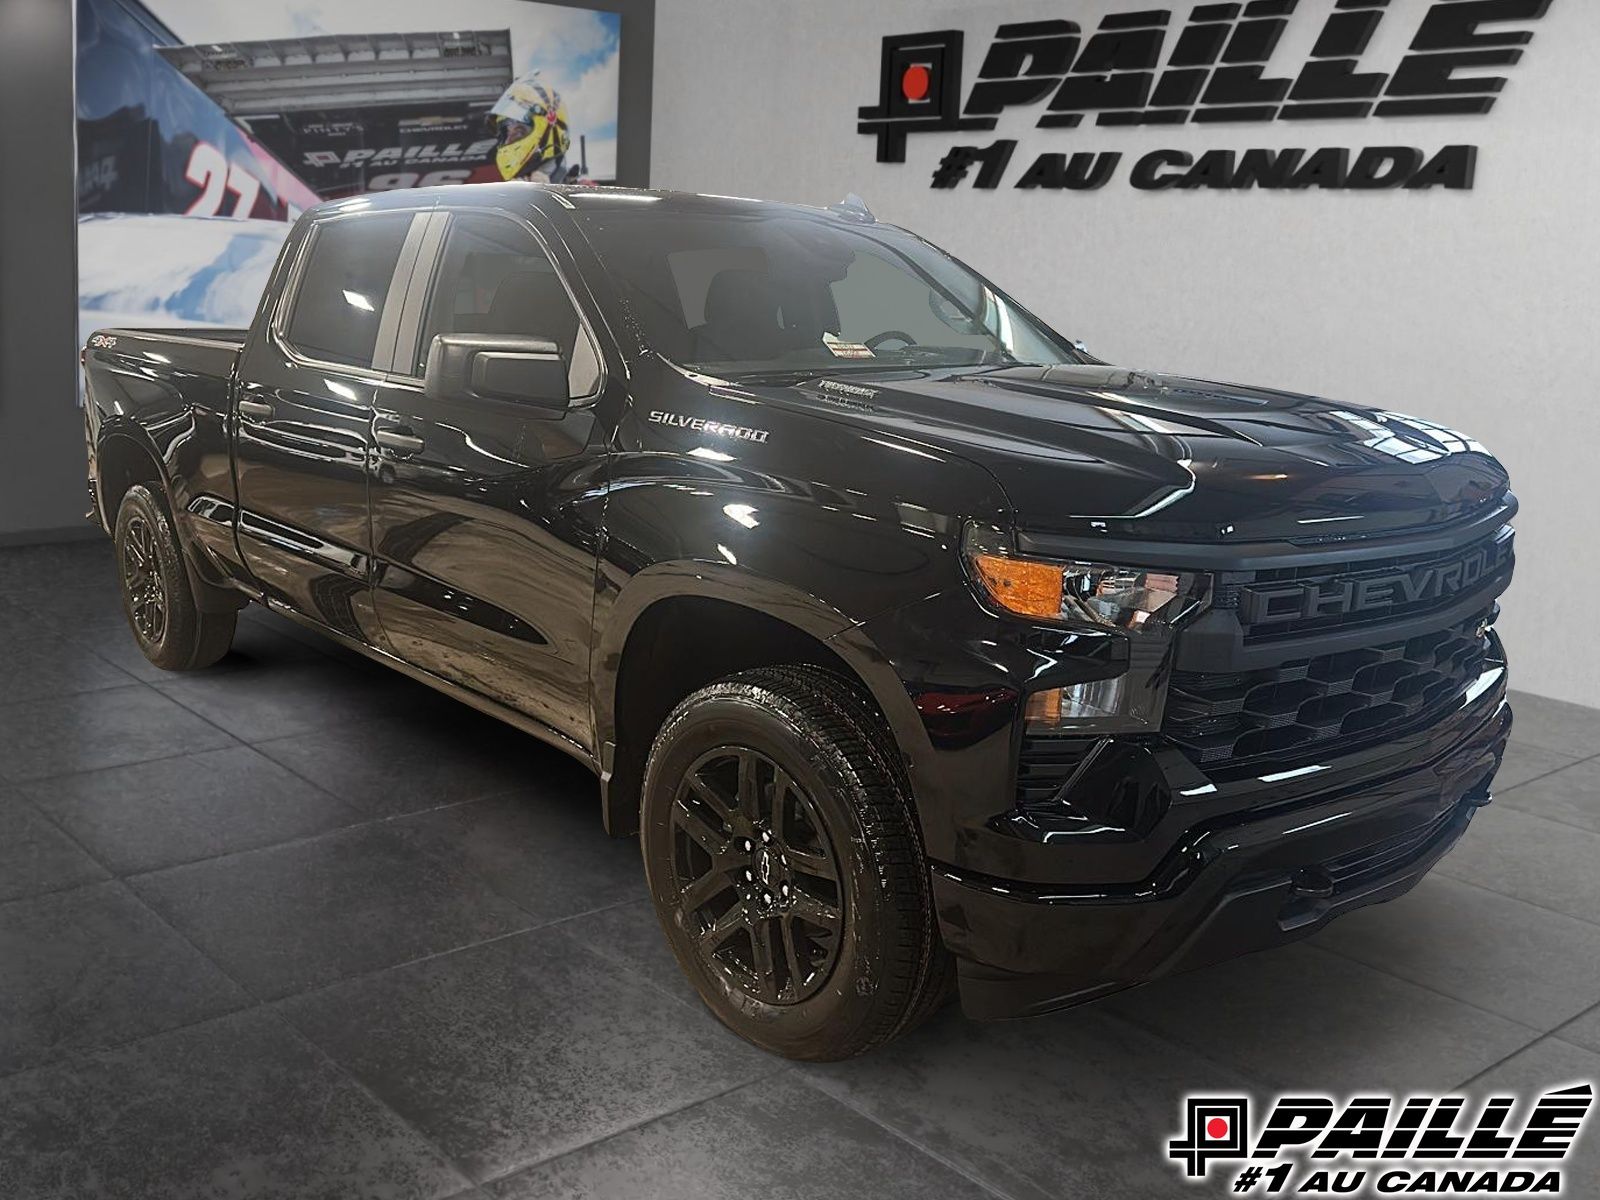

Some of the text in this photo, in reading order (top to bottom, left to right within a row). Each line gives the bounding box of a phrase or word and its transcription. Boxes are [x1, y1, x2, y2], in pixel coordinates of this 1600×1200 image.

[404, 154, 487, 165] CANADA
[930, 140, 1478, 191] #1 AU CANADA
[648, 410, 770, 443] SILVERADO
